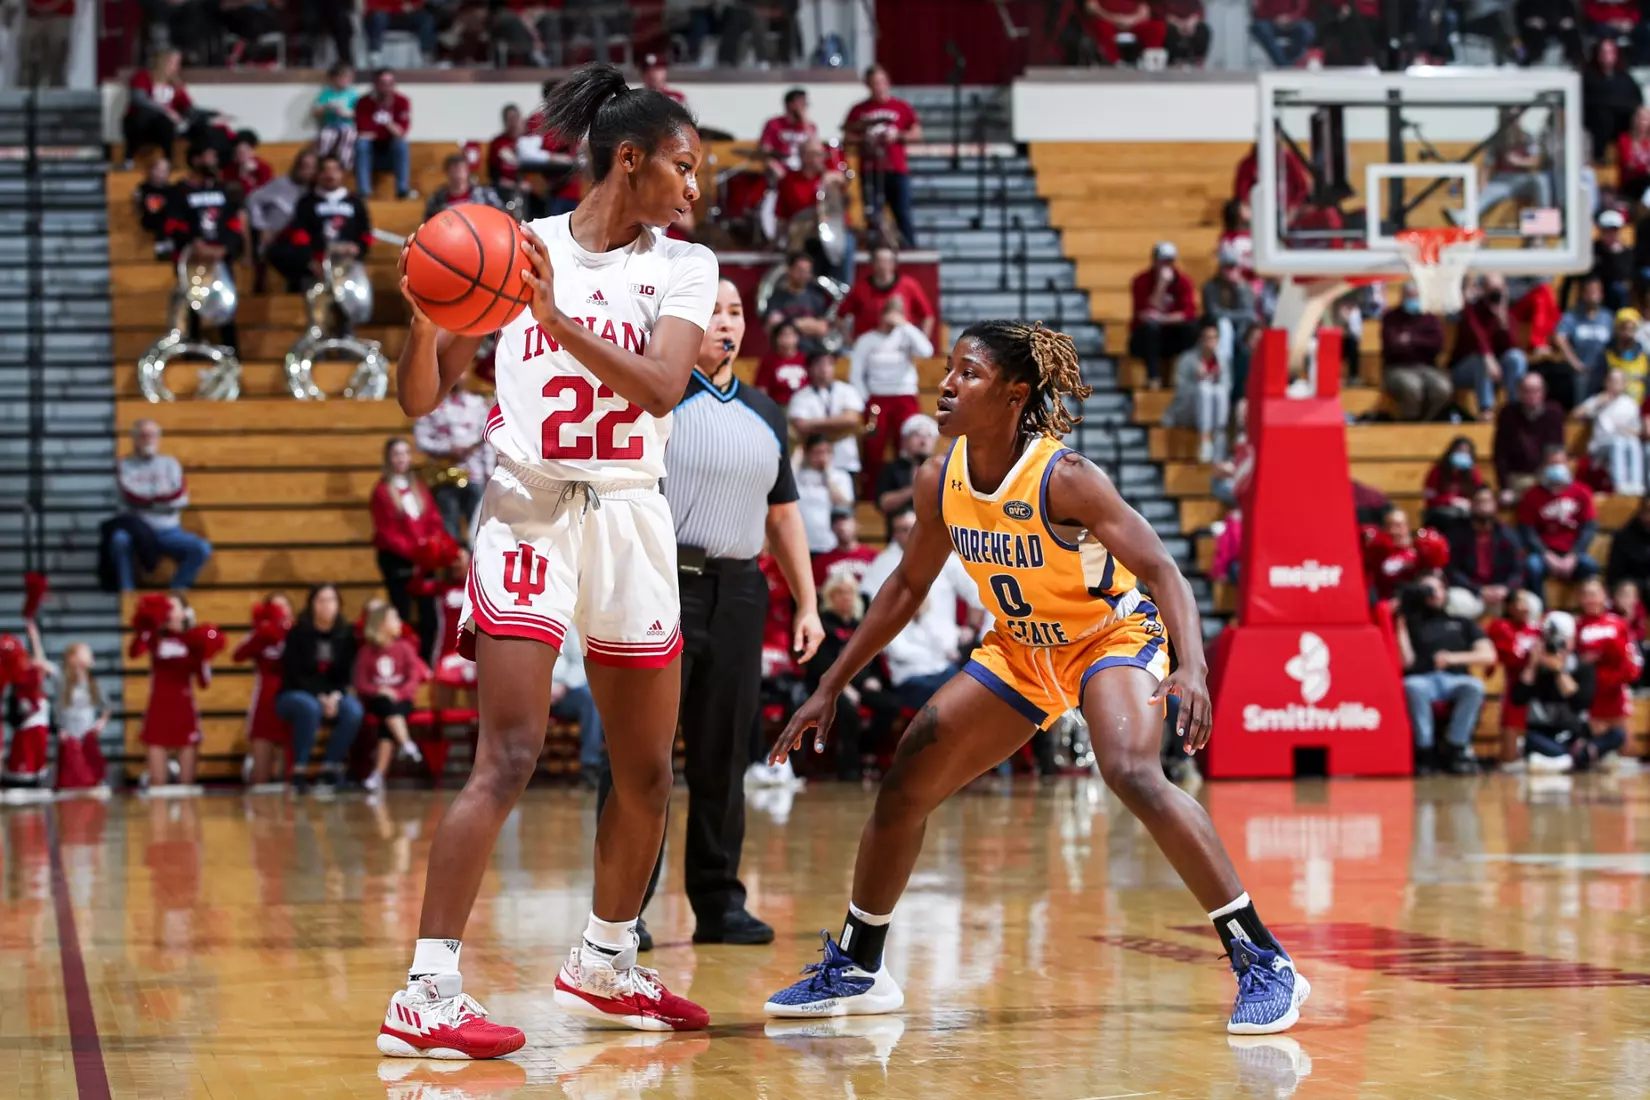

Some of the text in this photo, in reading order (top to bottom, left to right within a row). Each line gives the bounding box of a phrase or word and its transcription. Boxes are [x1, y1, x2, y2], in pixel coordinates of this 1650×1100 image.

[542, 376, 643, 460] 22
[1008, 507, 1027, 516] OVC
[949, 524, 1044, 568] MOREHEAD
[1269, 560, 1342, 592] meijer
[990, 574, 1032, 618] 0
[1007, 620, 1069, 645] STATE
[1243, 702, 1381, 731] Smithville
